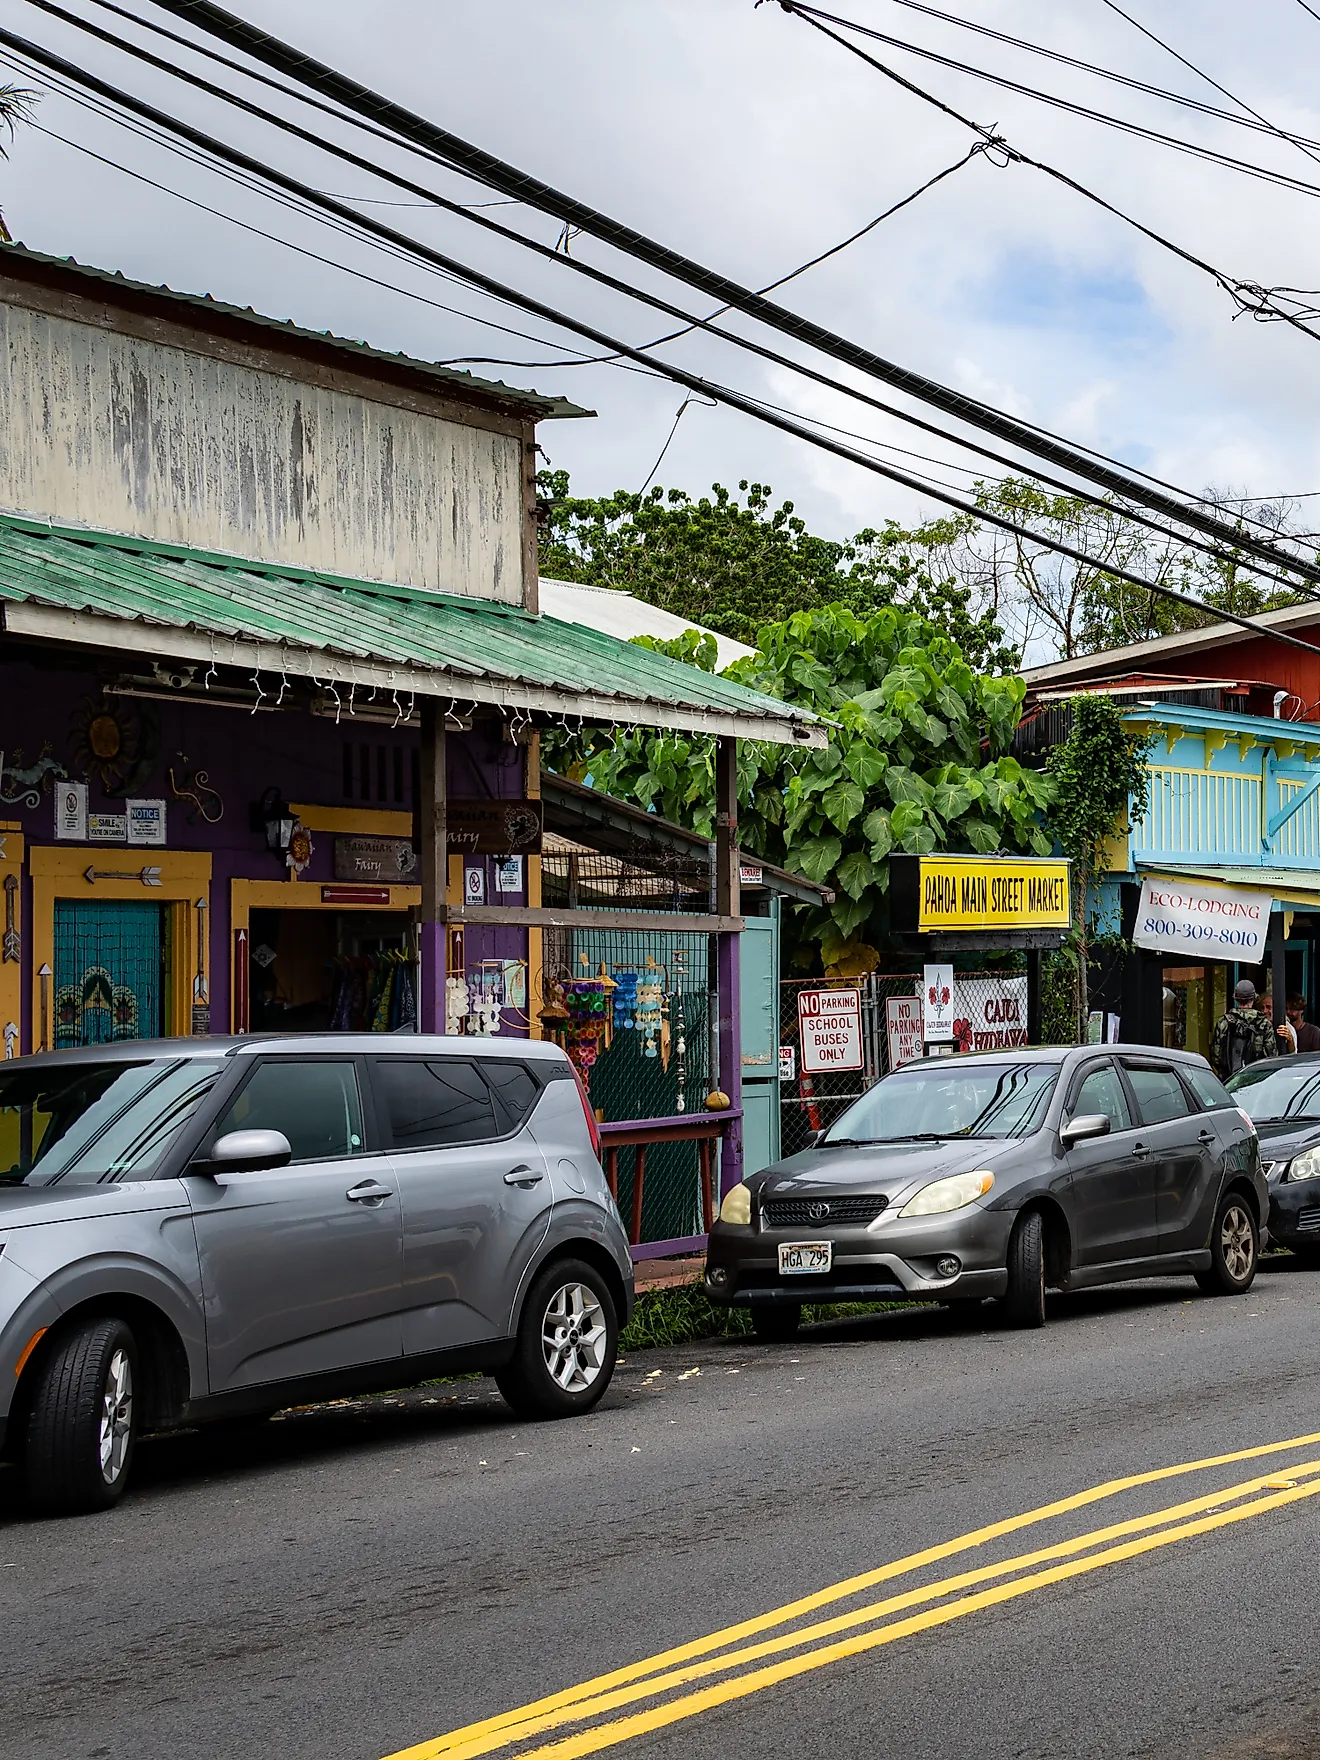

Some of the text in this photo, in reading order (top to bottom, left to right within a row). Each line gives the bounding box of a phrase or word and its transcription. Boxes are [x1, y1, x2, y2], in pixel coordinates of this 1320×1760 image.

[131, 809, 160, 819] NOTICE
[98, 818, 115, 827] SMILE
[446, 827, 480, 853] airy
[354, 857, 381, 879] Fairy
[925, 874, 1064, 914] PAHOA MAIN STREET MARKET
[1149, 891, 1260, 920] ECO-LODGING
[1144, 918, 1258, 947] 800-309-8010
[800, 995, 856, 1014] NO PARKING
[898, 1004, 911, 1018] NO
[808, 1017, 854, 1031] SCHOOL
[890, 1019, 920, 1034] PARKING
[814, 1032, 848, 1046] BUSES
[899, 1034, 912, 1046] ANY
[974, 1028, 1028, 1050] HIDEAWA
[820, 1048, 846, 1061] ONLY
[899, 1046, 914, 1058] TIME
[782, 1250, 829, 1267] HGA 295
